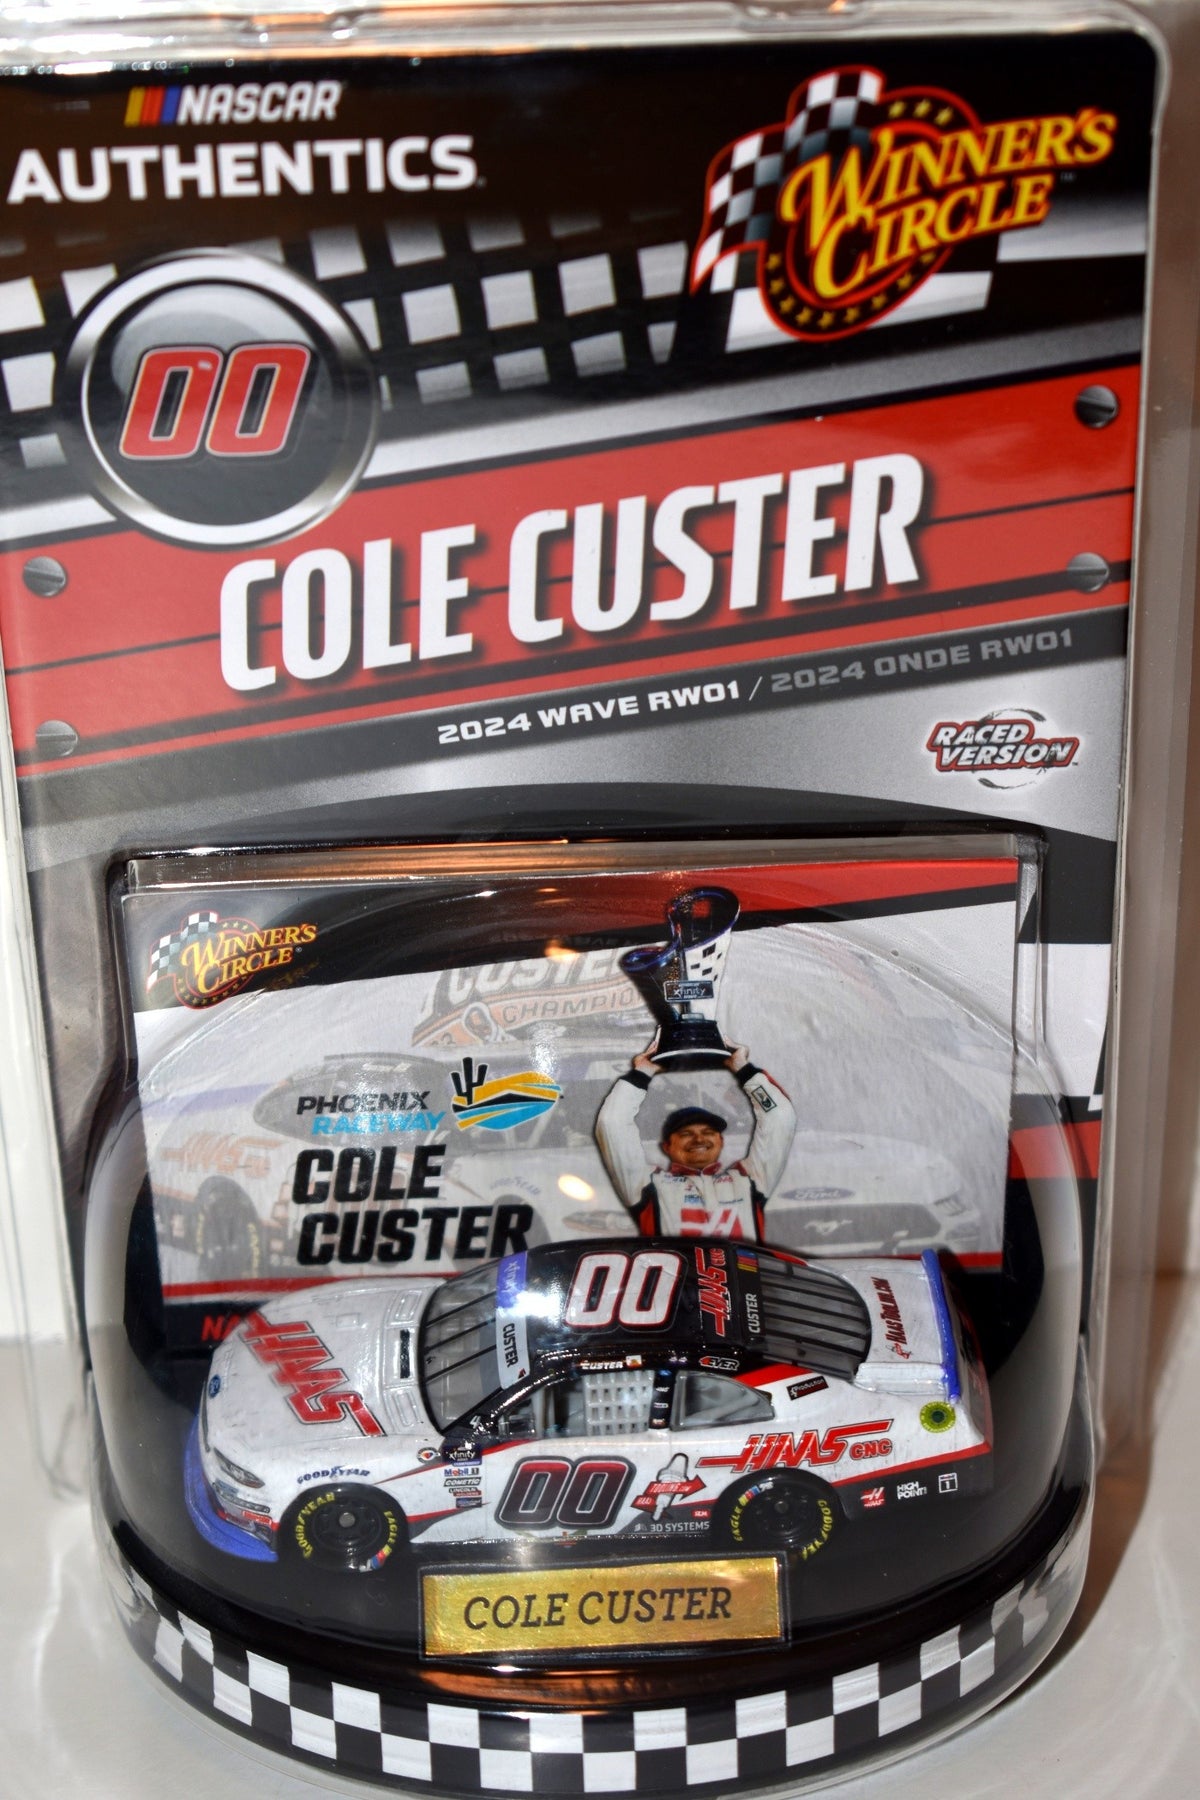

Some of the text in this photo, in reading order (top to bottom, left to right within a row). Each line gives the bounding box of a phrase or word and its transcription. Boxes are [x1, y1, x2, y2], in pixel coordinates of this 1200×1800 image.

[177, 80, 342, 125] NASCAR
[7, 134, 478, 204] AUTHENTICS
[779, 108, 1117, 252] WINNER'S
[812, 173, 1052, 299] CIRCLE
[118, 343, 312, 460] 00
[219, 453, 924, 692] COLE CUSTER
[437, 714, 531, 744] 2024
[537, 697, 640, 728] WAVE
[771, 661, 867, 693] 2024
[874, 645, 970, 677] ONDE
[932, 723, 1030, 746] RACED
[940, 742, 1074, 767] VERSION
[181, 923, 318, 976] WINNER'S
[197, 947, 293, 994] CIRCLE
[502, 983, 648, 1024] CHAMPIO
[296, 1090, 431, 1116] PHOENIX
[312, 1110, 447, 1136] RACEWAY
[292, 1143, 447, 1205] COLE
[296, 1203, 534, 1266] CUSTER
[564, 1251, 683, 1329] 00
[745, 1292, 761, 1334] CUSTER
[502, 1322, 520, 1368] CUSTER
[698, 1418, 894, 1474] HAAS CNC
[497, 1456, 634, 1529] 00
[897, 1480, 920, 1493] HIGH
[650, 1520, 711, 1532] 3D SYSTEMS
[464, 1586, 732, 1631] COLE CUSTER
